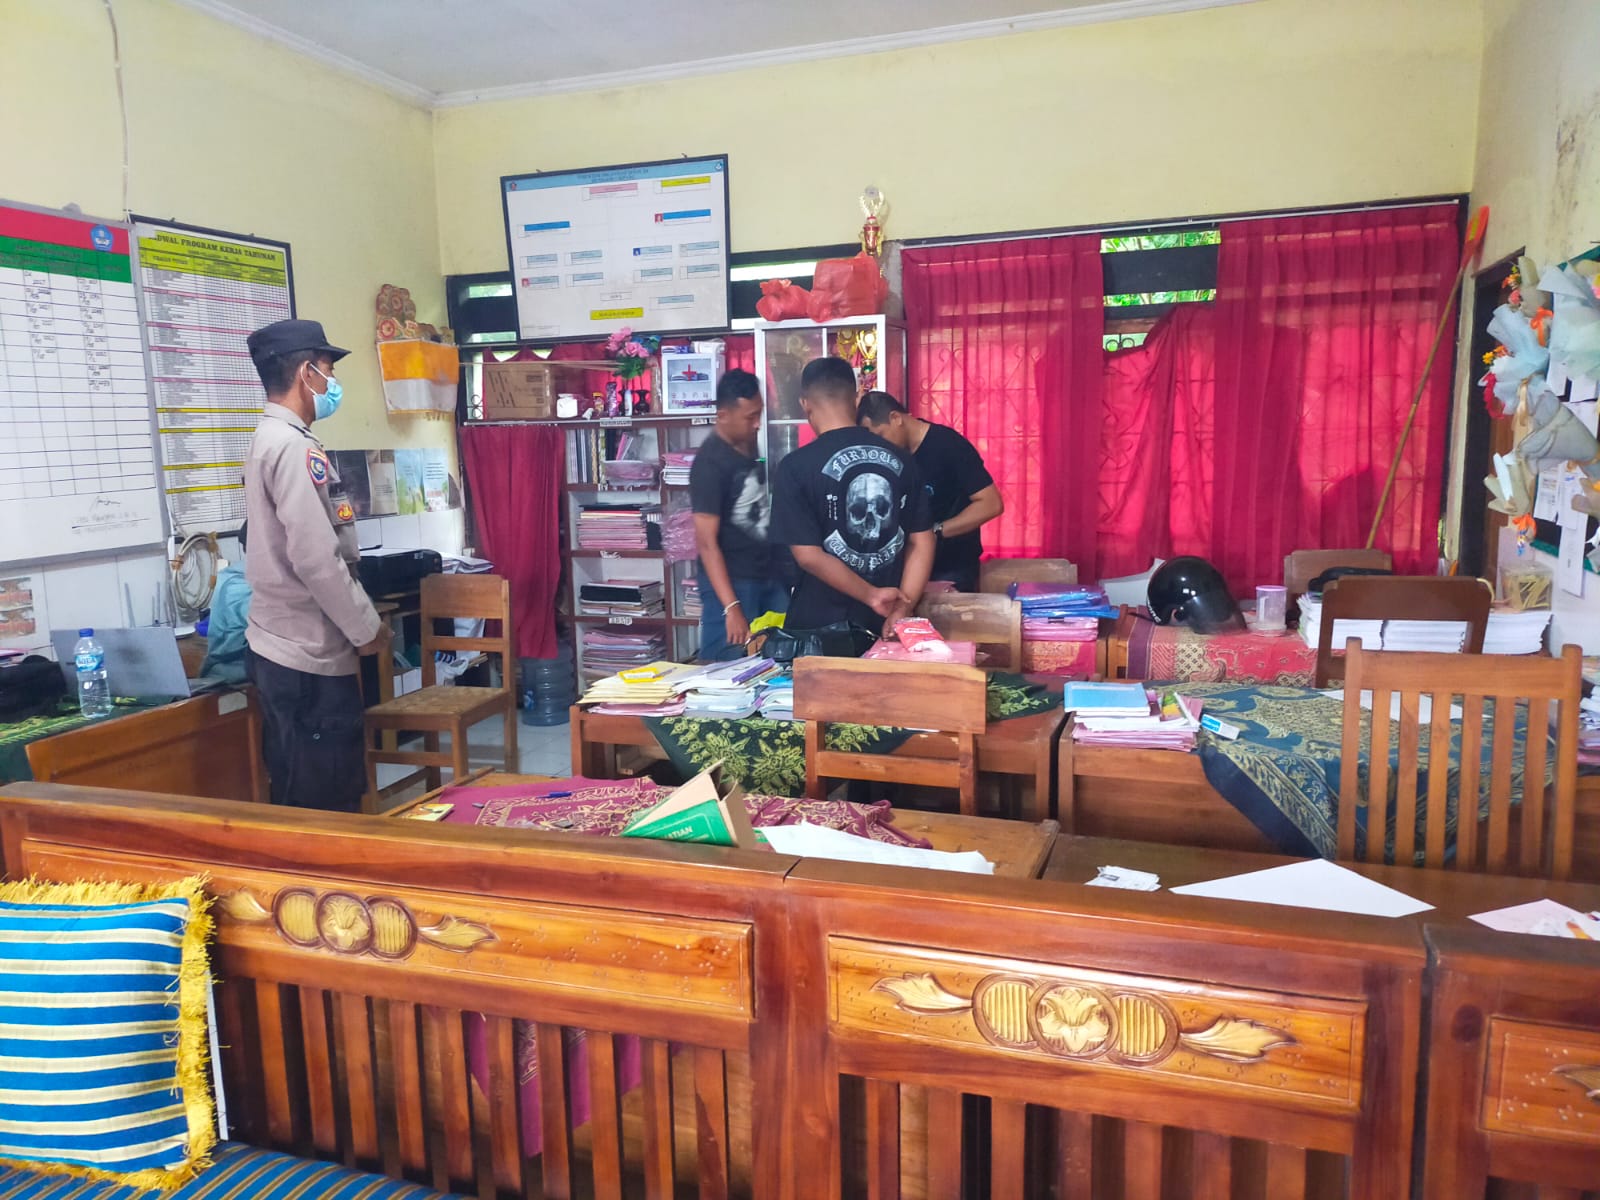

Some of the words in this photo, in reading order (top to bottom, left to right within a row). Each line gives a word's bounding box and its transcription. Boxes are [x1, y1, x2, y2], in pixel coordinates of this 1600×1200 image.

[150, 234, 179, 245] DWAL
[181, 238, 219, 252] PROGRAM
[220, 245, 243, 256] KERJA
[244, 250, 276, 261] TAHUNAN
